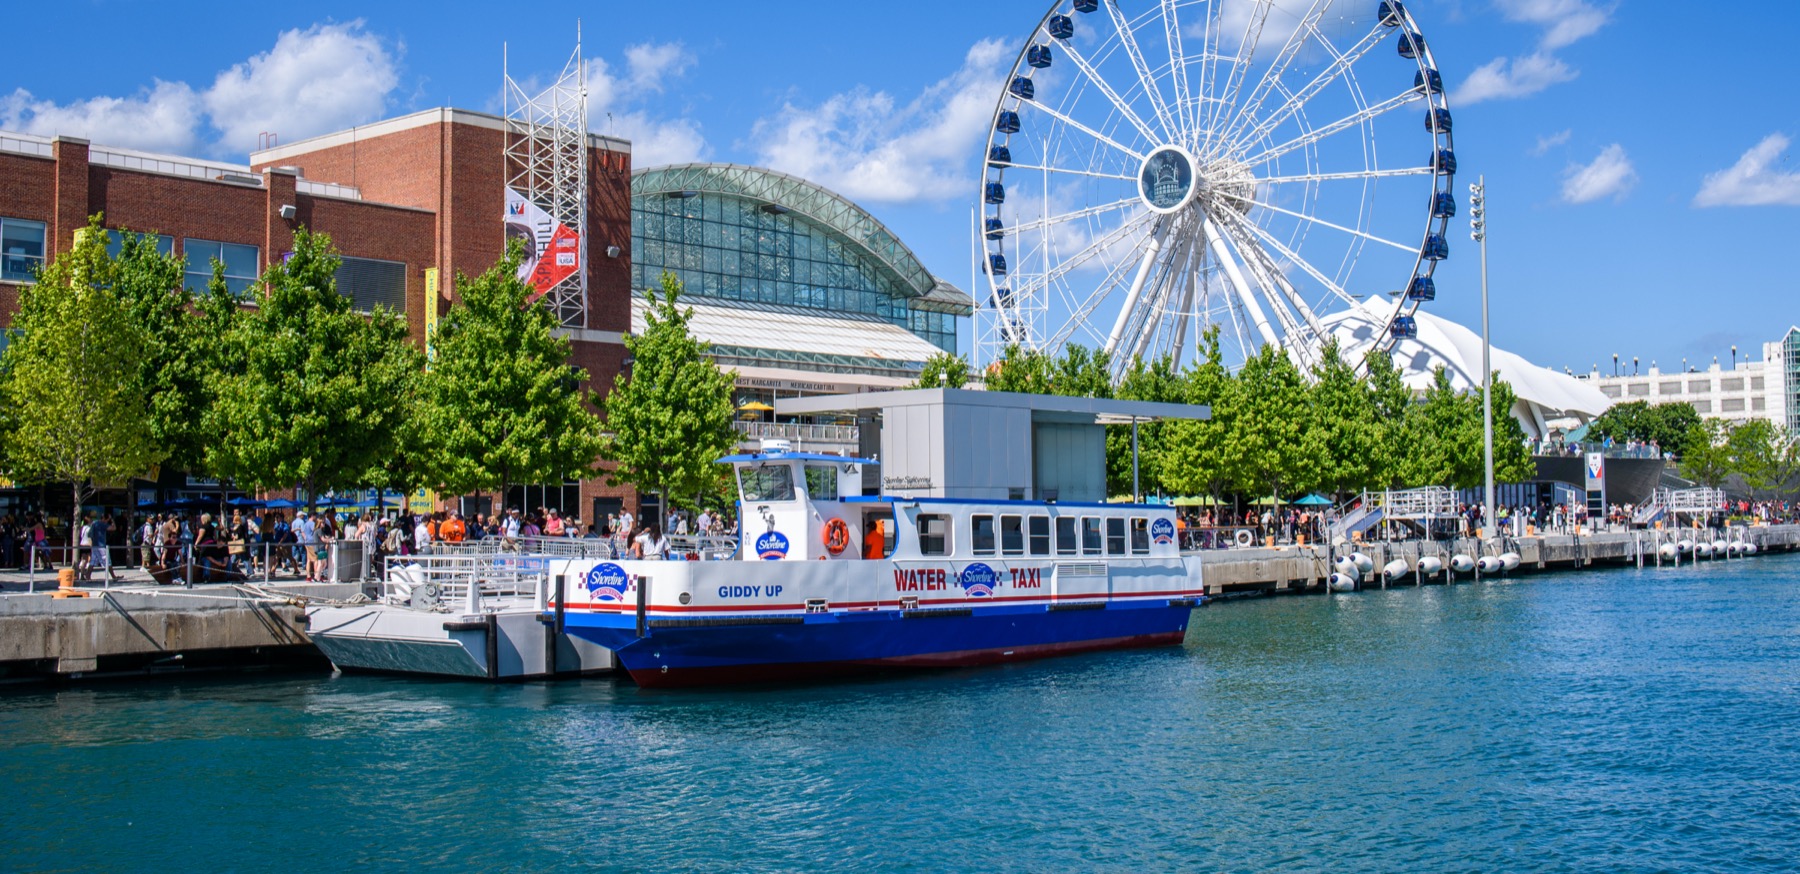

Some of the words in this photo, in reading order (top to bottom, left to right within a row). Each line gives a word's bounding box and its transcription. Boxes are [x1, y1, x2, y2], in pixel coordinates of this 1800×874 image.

[537, 219, 552, 285] SPITHILL
[752, 379, 782, 388] MARGARITA
[790, 381, 813, 390] MEXICAN
[813, 383, 835, 392] CANTINA
[758, 539, 786, 550] Shoreline
[590, 570, 625, 586] Shoreline
[894, 568, 947, 591] WATER
[964, 570, 993, 583] Shoreline
[1010, 567, 1041, 588] TAXI
[718, 585, 761, 598] GIDDY
[765, 585, 783, 597] UP
